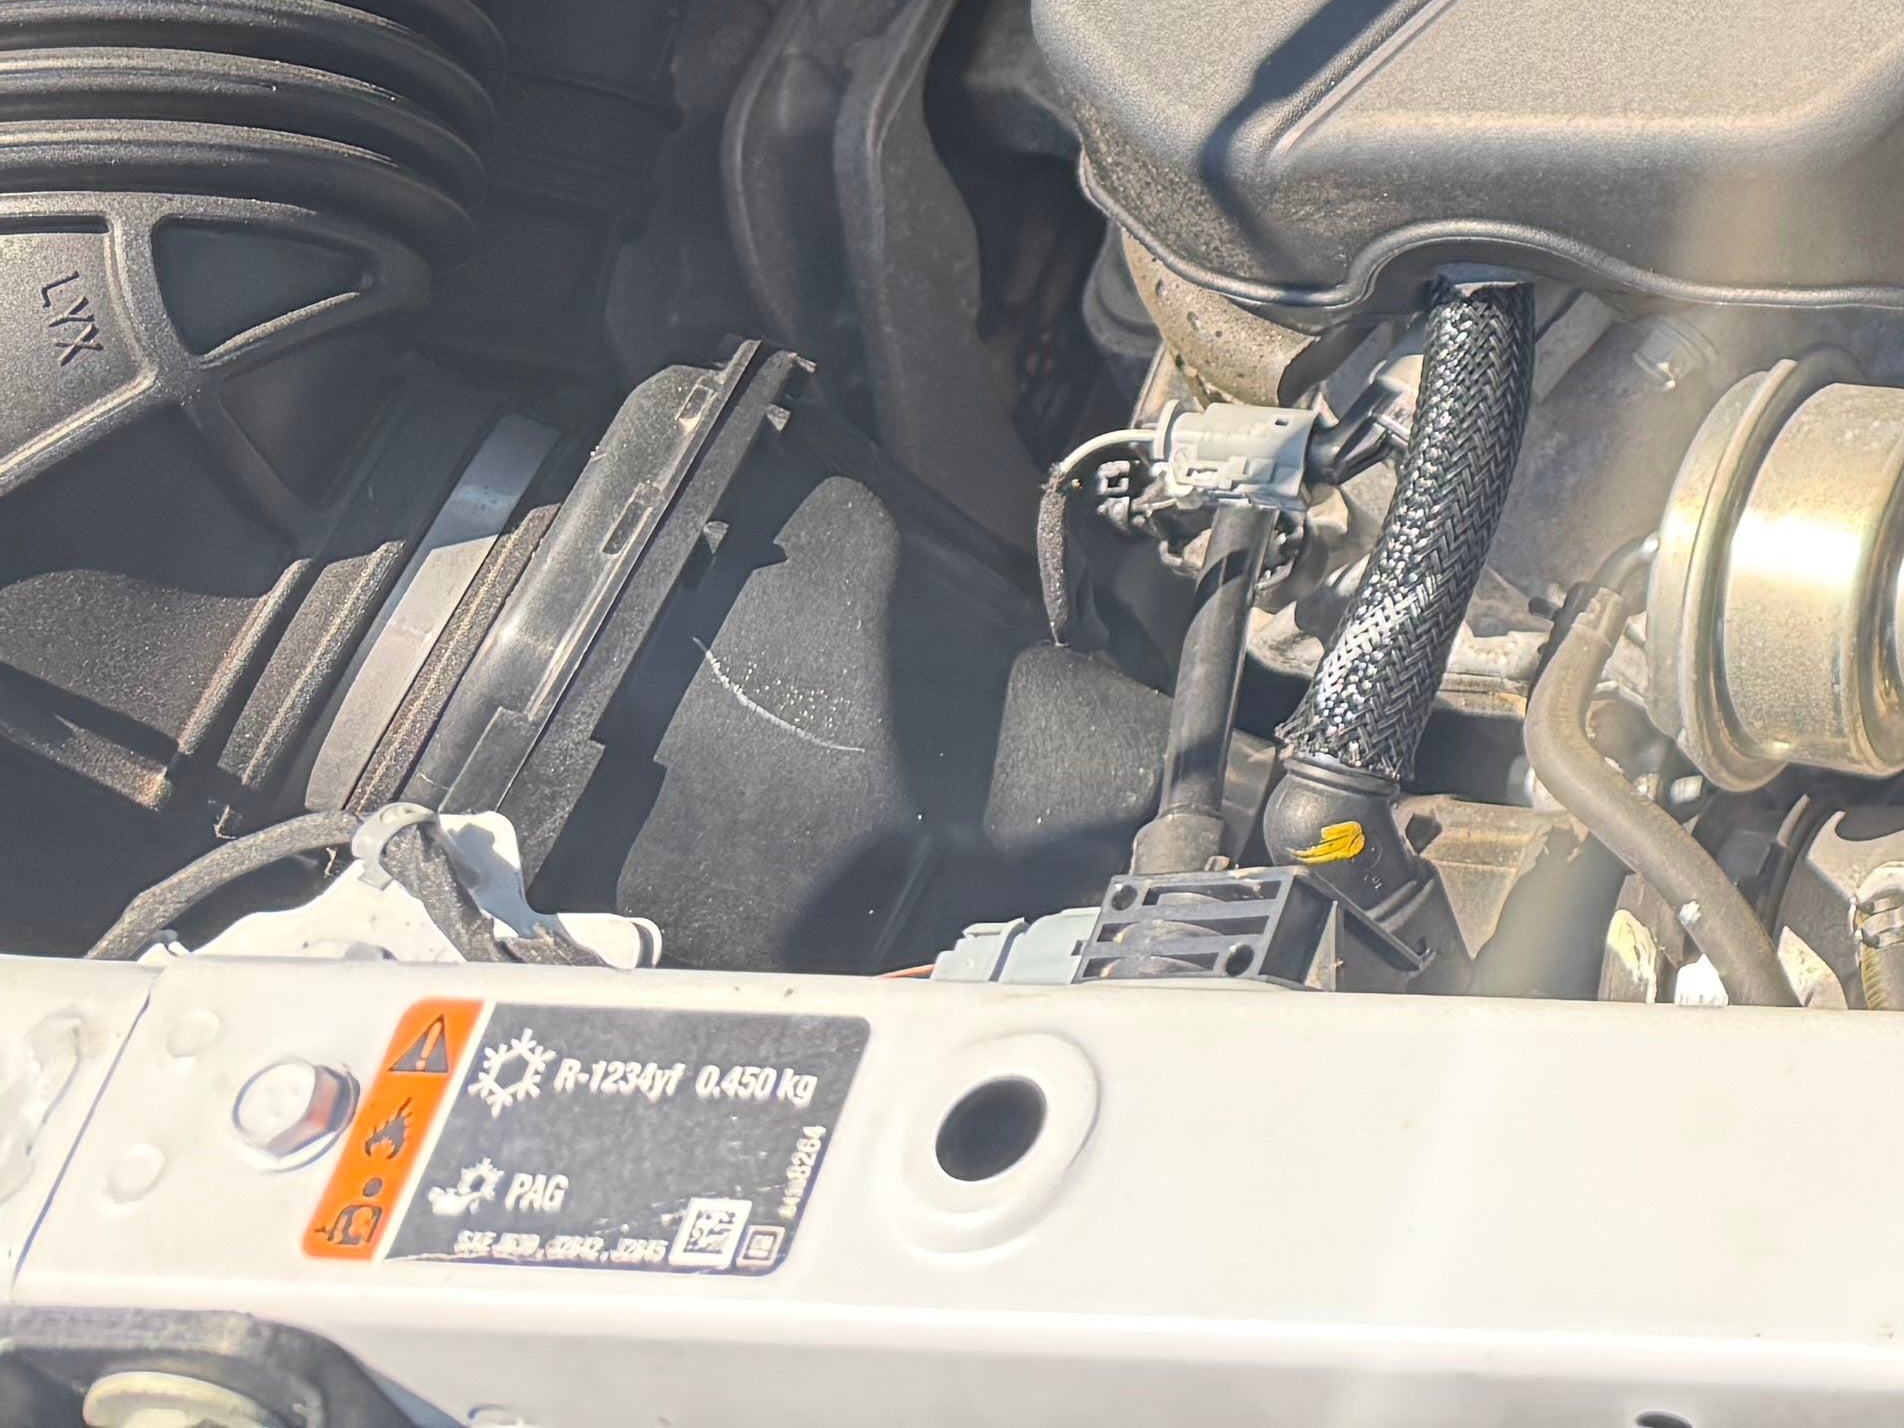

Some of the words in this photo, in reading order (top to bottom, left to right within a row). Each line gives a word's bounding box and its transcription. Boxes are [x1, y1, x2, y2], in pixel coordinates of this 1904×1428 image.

[40, 269, 104, 367] LYX
[554, 1058, 687, 1103] R-1234yf
[695, 1065, 776, 1100] 0.450
[775, 1067, 819, 1109] kg
[504, 1172, 570, 1213] PAG
